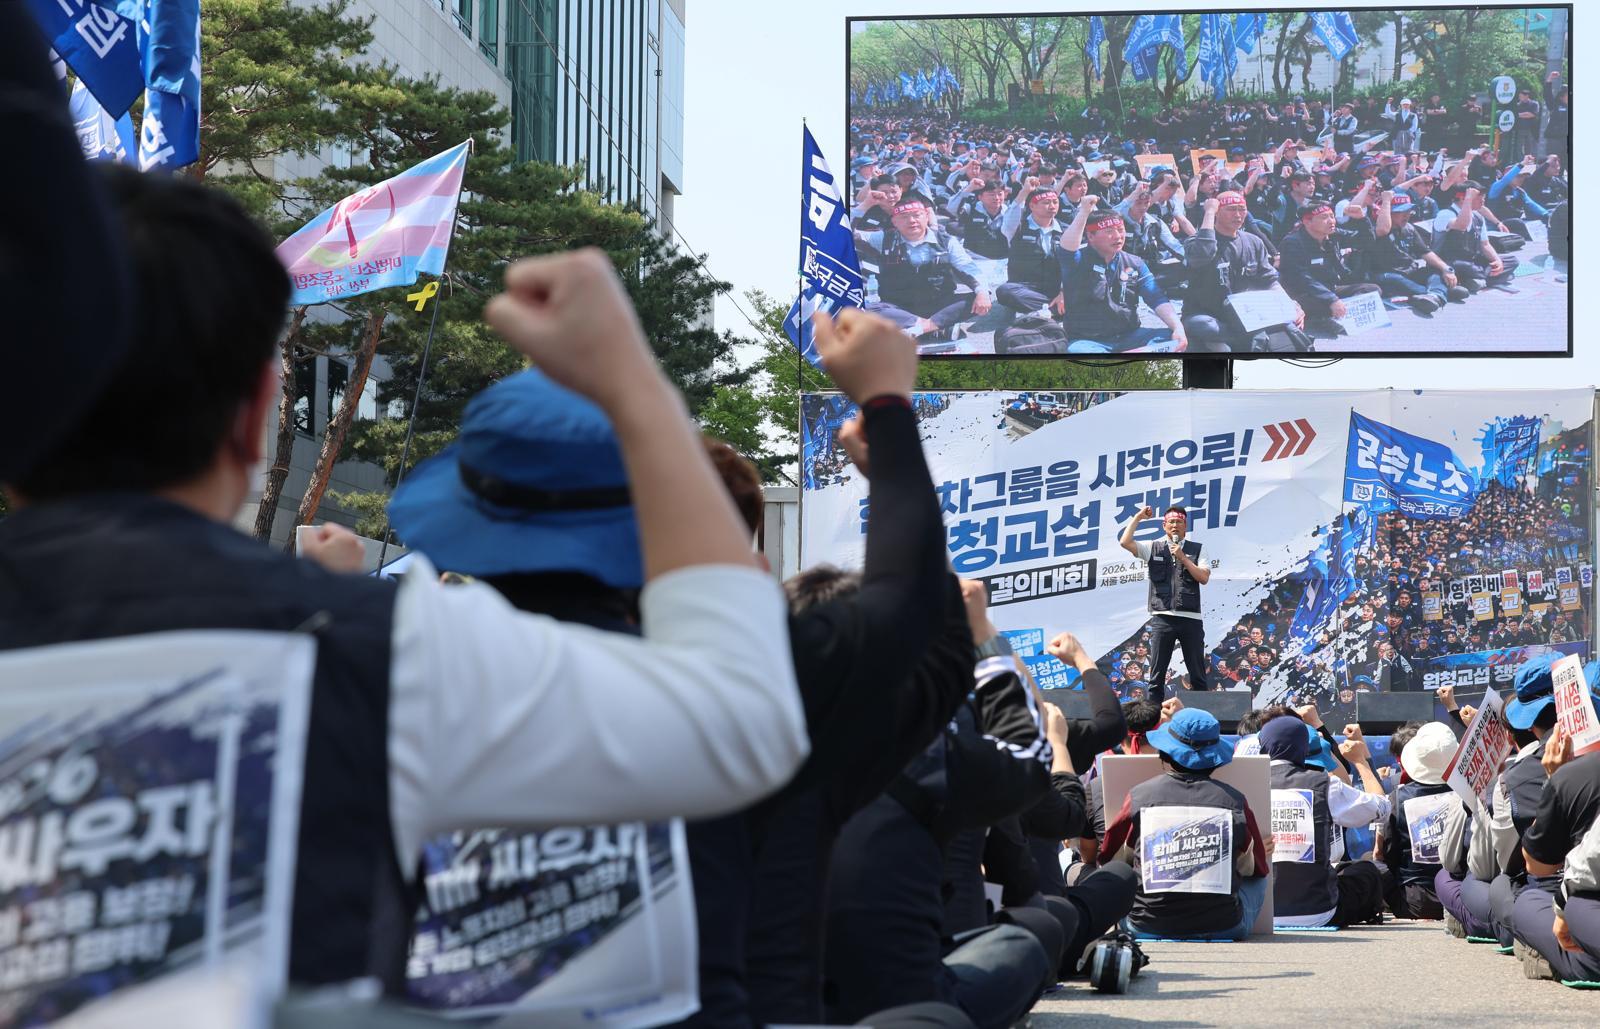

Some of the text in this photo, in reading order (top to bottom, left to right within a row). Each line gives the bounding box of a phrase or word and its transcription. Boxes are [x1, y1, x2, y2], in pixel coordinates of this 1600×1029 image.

[1089, 429, 1254, 491] 시작으로!
[946, 475, 1247, 573] 청교섭 쟁취!
[1102, 564, 1127, 575] 2026.
[1129, 561, 1137, 570] 4.
[991, 563, 1090, 603] 결의대회
[1100, 576, 1118, 587] 서울
[1119, 572, 1144, 585] 양재동
[1008, 630, 1042, 650] 청교섭
[1025, 658, 1072, 678] 원청교
[1423, 665, 1489, 690] 원청교섭
[1039, 672, 1068, 690] 쟁취
[1280, 808, 1305, 820] 비정규직
[1173, 825, 1200, 841] 2026
[1271, 820, 1297, 832] 동자에게
[1153, 833, 1222, 858] 함께 싸우자
